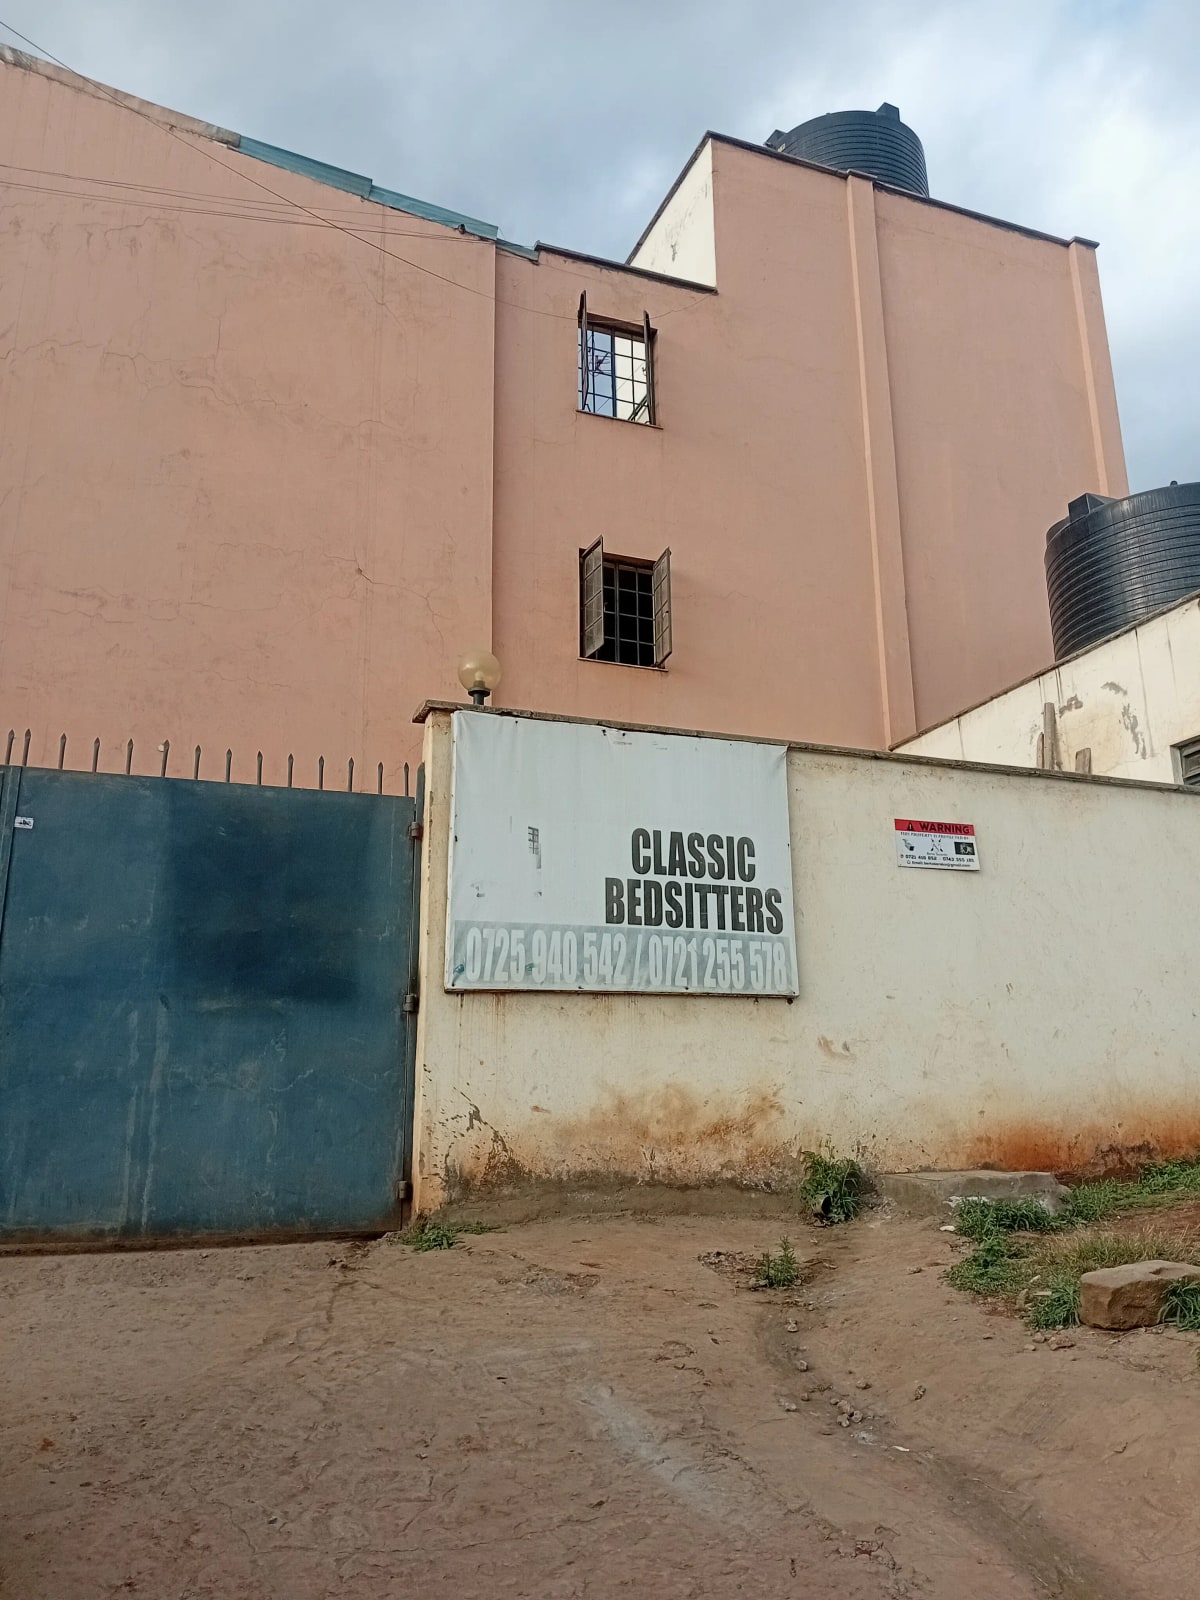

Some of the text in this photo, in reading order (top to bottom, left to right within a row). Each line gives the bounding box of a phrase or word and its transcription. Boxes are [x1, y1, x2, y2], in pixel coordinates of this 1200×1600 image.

[631, 827, 756, 882] CLASSIC
[919, 822, 970, 834] WARNING
[605, 877, 783, 934] BEDSITTERS
[466, 927, 526, 983] 0725
[532, 929, 578, 984] 940
[583, 932, 627, 985] 542
[648, 935, 699, 987] 0721
[702, 938, 745, 990] 255
[750, 940, 788, 991] 578
